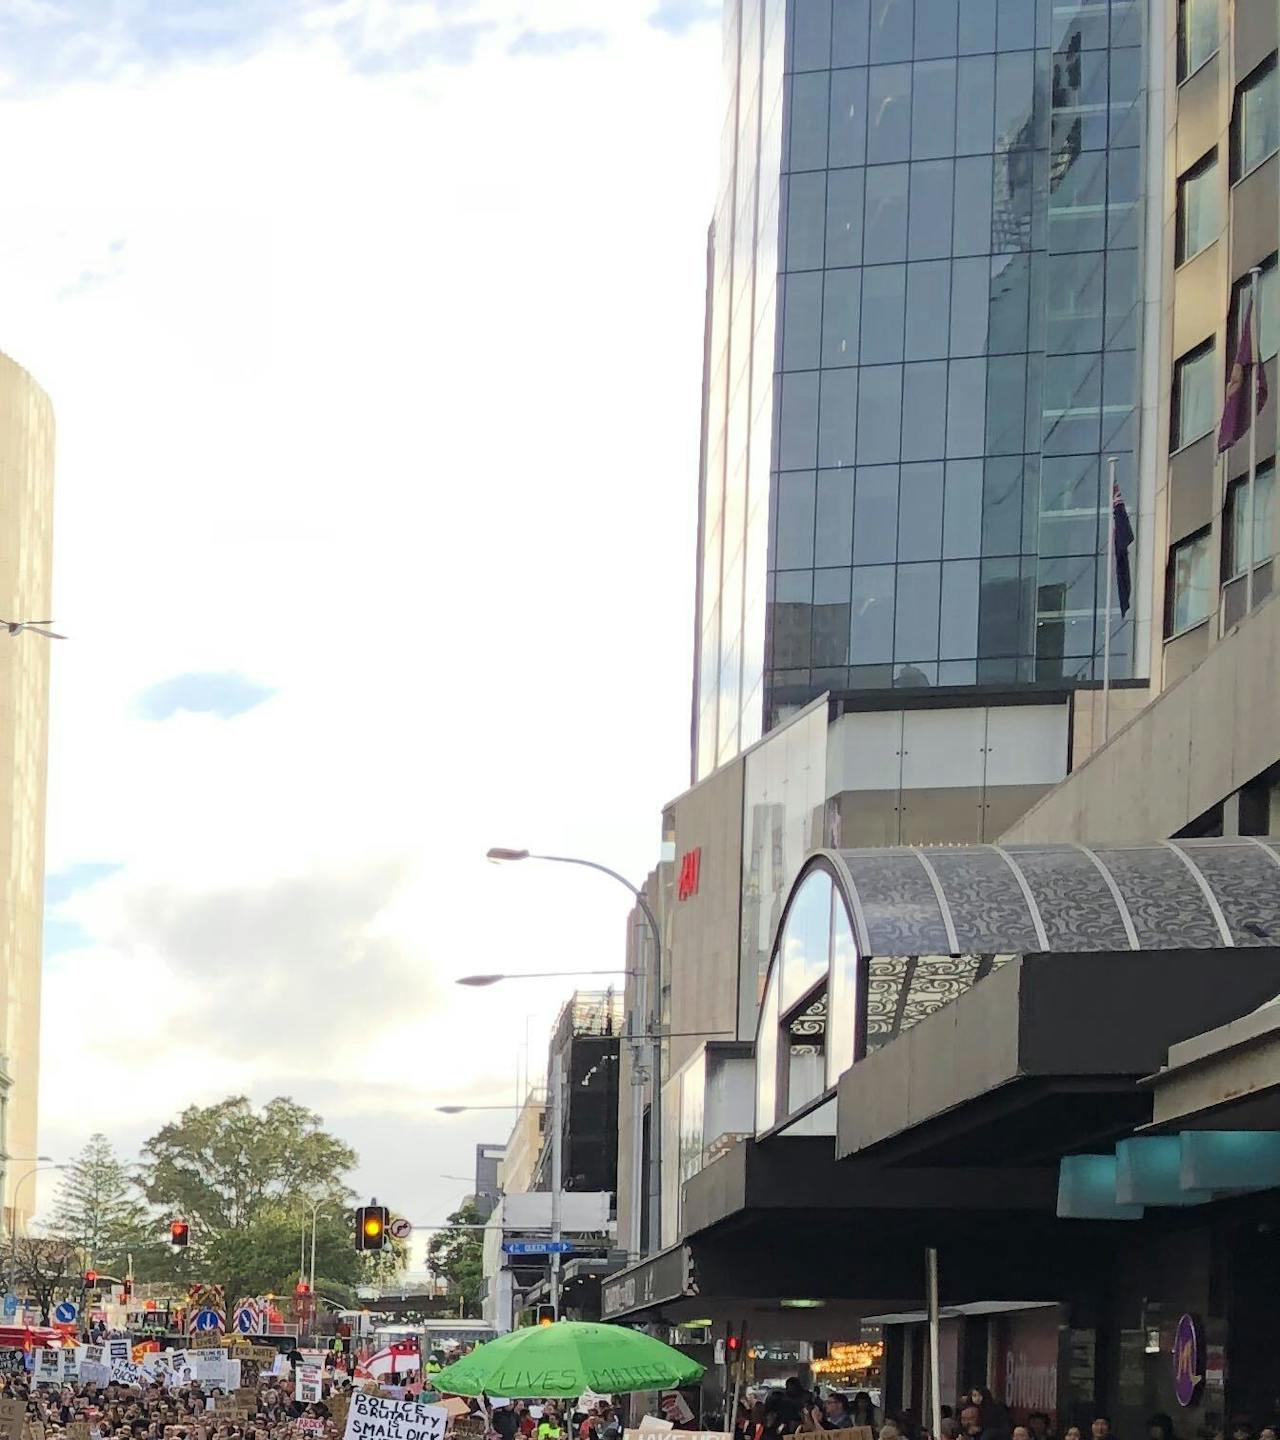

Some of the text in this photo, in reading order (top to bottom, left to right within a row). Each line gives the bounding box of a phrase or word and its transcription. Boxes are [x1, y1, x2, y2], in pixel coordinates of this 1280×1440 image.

[500, 1369, 577, 1390] LIVES
[592, 1362, 669, 1387] MATTER
[355, 1394, 425, 1415] POLICE
[357, 1403, 440, 1428] BRUTALITY
[388, 1420, 400, 1428] IS
[352, 1420, 402, 1439] SMALL
